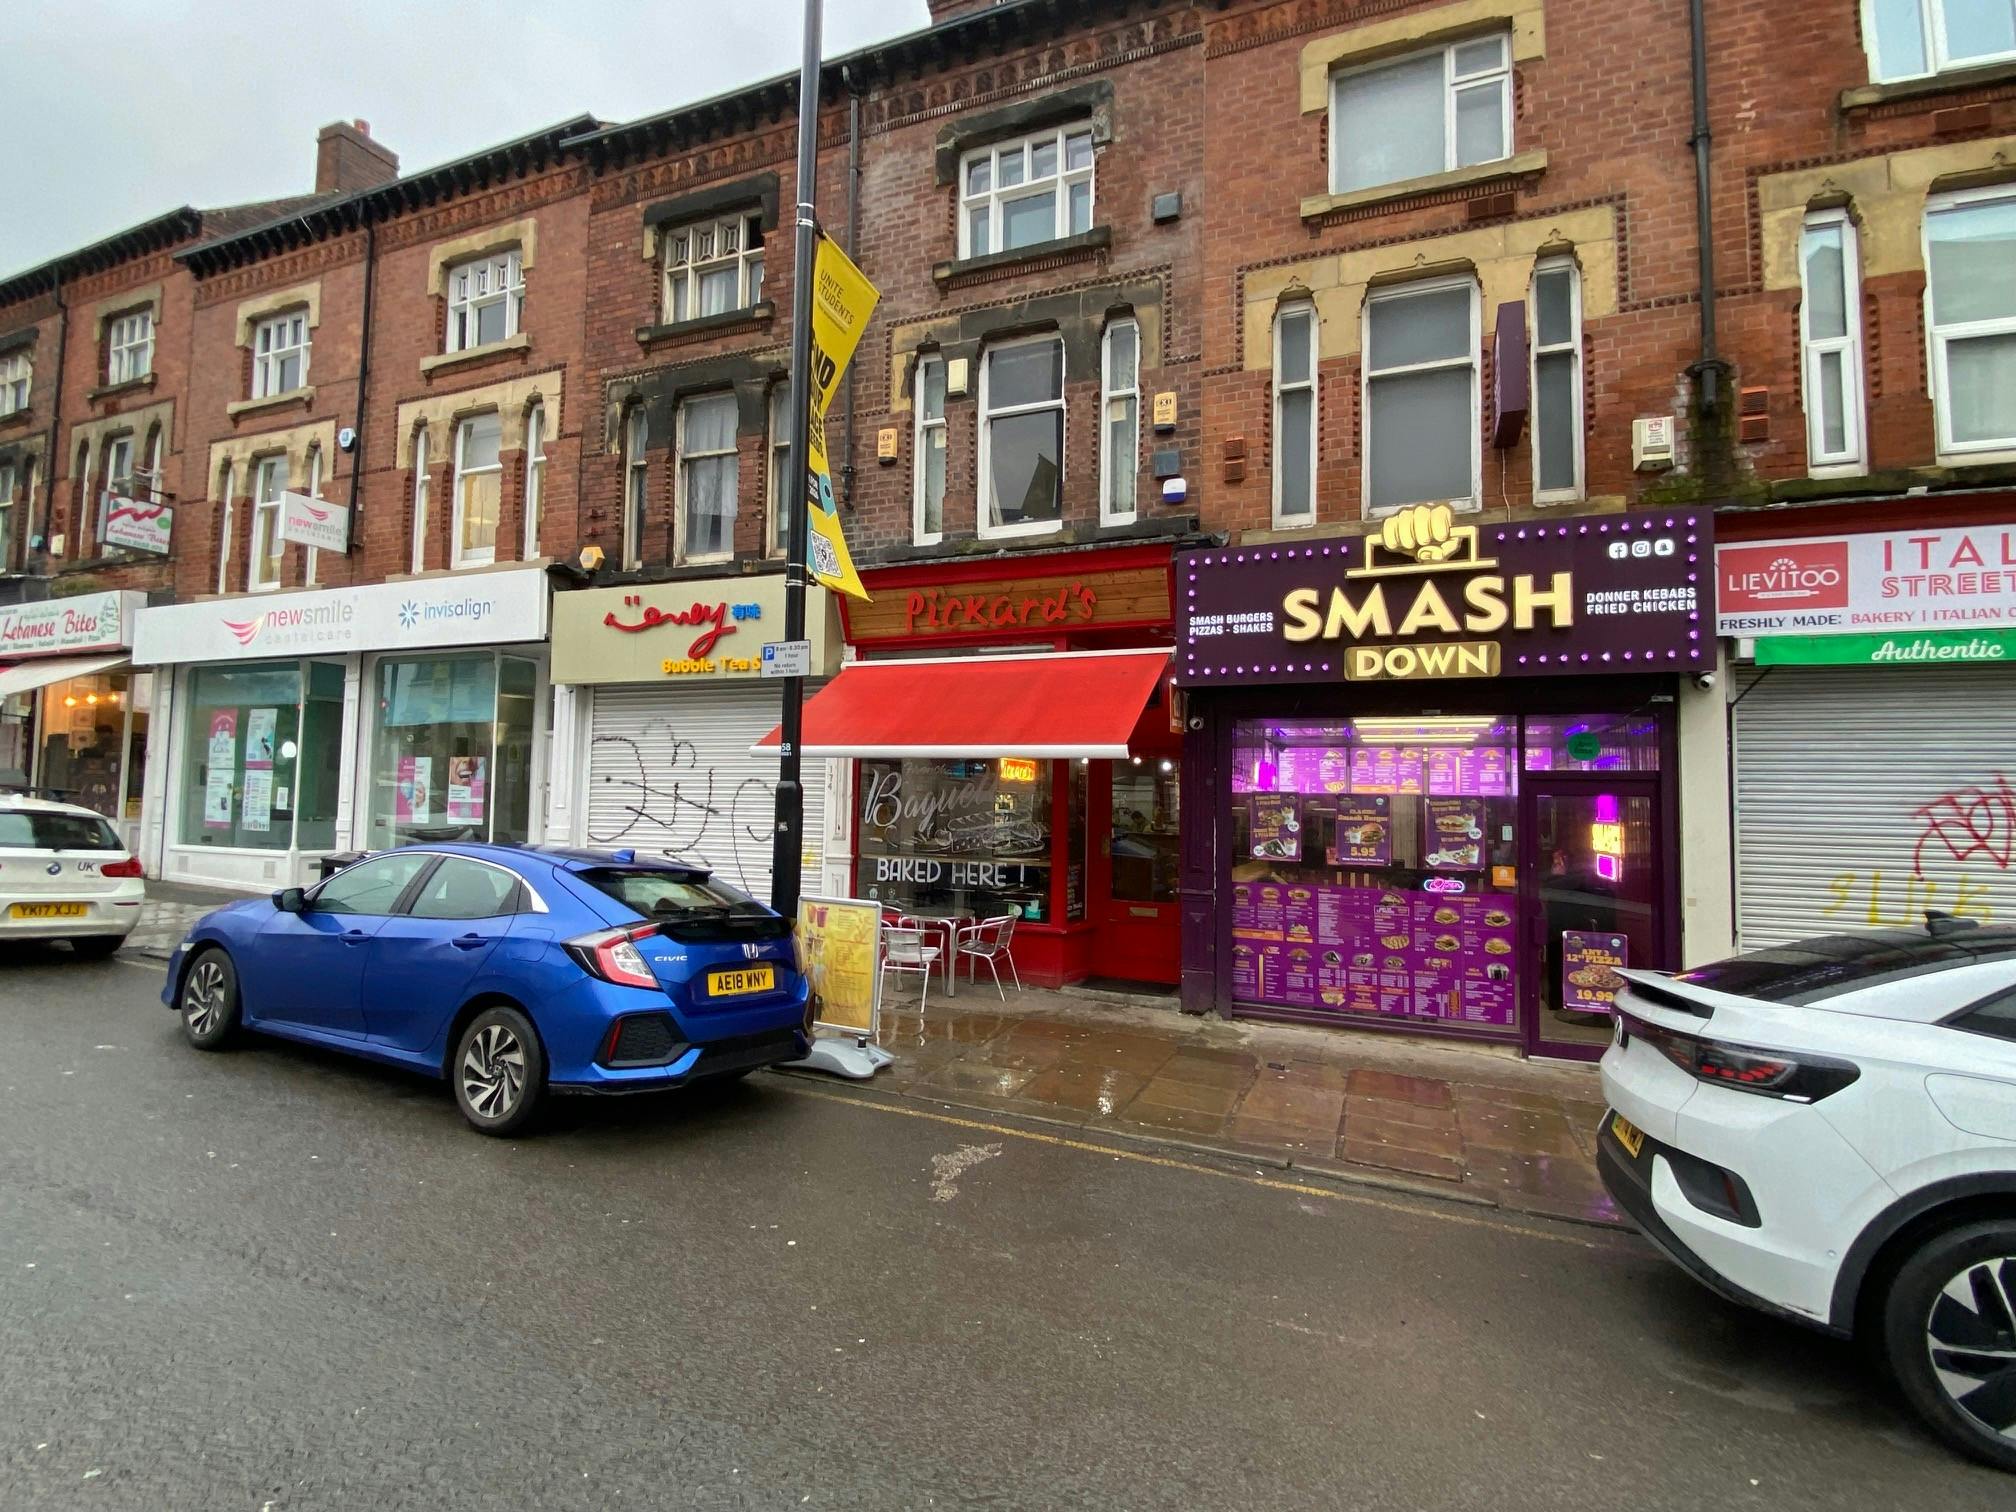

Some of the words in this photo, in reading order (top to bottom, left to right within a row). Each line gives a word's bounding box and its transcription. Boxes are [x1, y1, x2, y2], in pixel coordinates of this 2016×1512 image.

[820, 269, 843, 299] UNITE
[819, 281, 854, 325] STUDENTS
[1728, 569, 1840, 592] LIEVITOO
[1586, 591, 1640, 603] DONNER
[1643, 587, 1697, 600] KEBABS
[266, 600, 353, 628] newsmile
[424, 598, 491, 620] invisalign
[1282, 571, 1575, 643] SMASH
[1586, 603, 1629, 616] FRIED
[1632, 599, 1697, 612] CHICKEN
[2, 615, 56, 640] Lebanese
[62, 609, 98, 634] Bites
[1189, 614, 1224, 626] SMASH
[1226, 612, 1274, 625] BURGERS
[1189, 625, 1224, 636] PIZZAS
[1232, 622, 1274, 634] SHAKES
[1719, 616, 1786, 630] FRESHLY
[1792, 614, 1842, 627] MADE:
[1851, 612, 1914, 625] BAKERY
[1933, 607, 2001, 621] ITALIAN
[1871, 638, 2005, 662] Authentic
[661, 657, 715, 675] Bubble
[720, 655, 749, 673] Tea
[1355, 645, 1488, 678] DOWN
[1350, 846, 1377, 857] 5.95
[78, 861, 96, 872] UK
[876, 857, 942, 883] BAKED
[951, 861, 1008, 887] HERE
[1584, 955, 1623, 966] PIZZA
[717, 973, 743, 992] AE18
[746, 971, 767, 989] WNY
[1576, 988, 1614, 1003] 19.99
